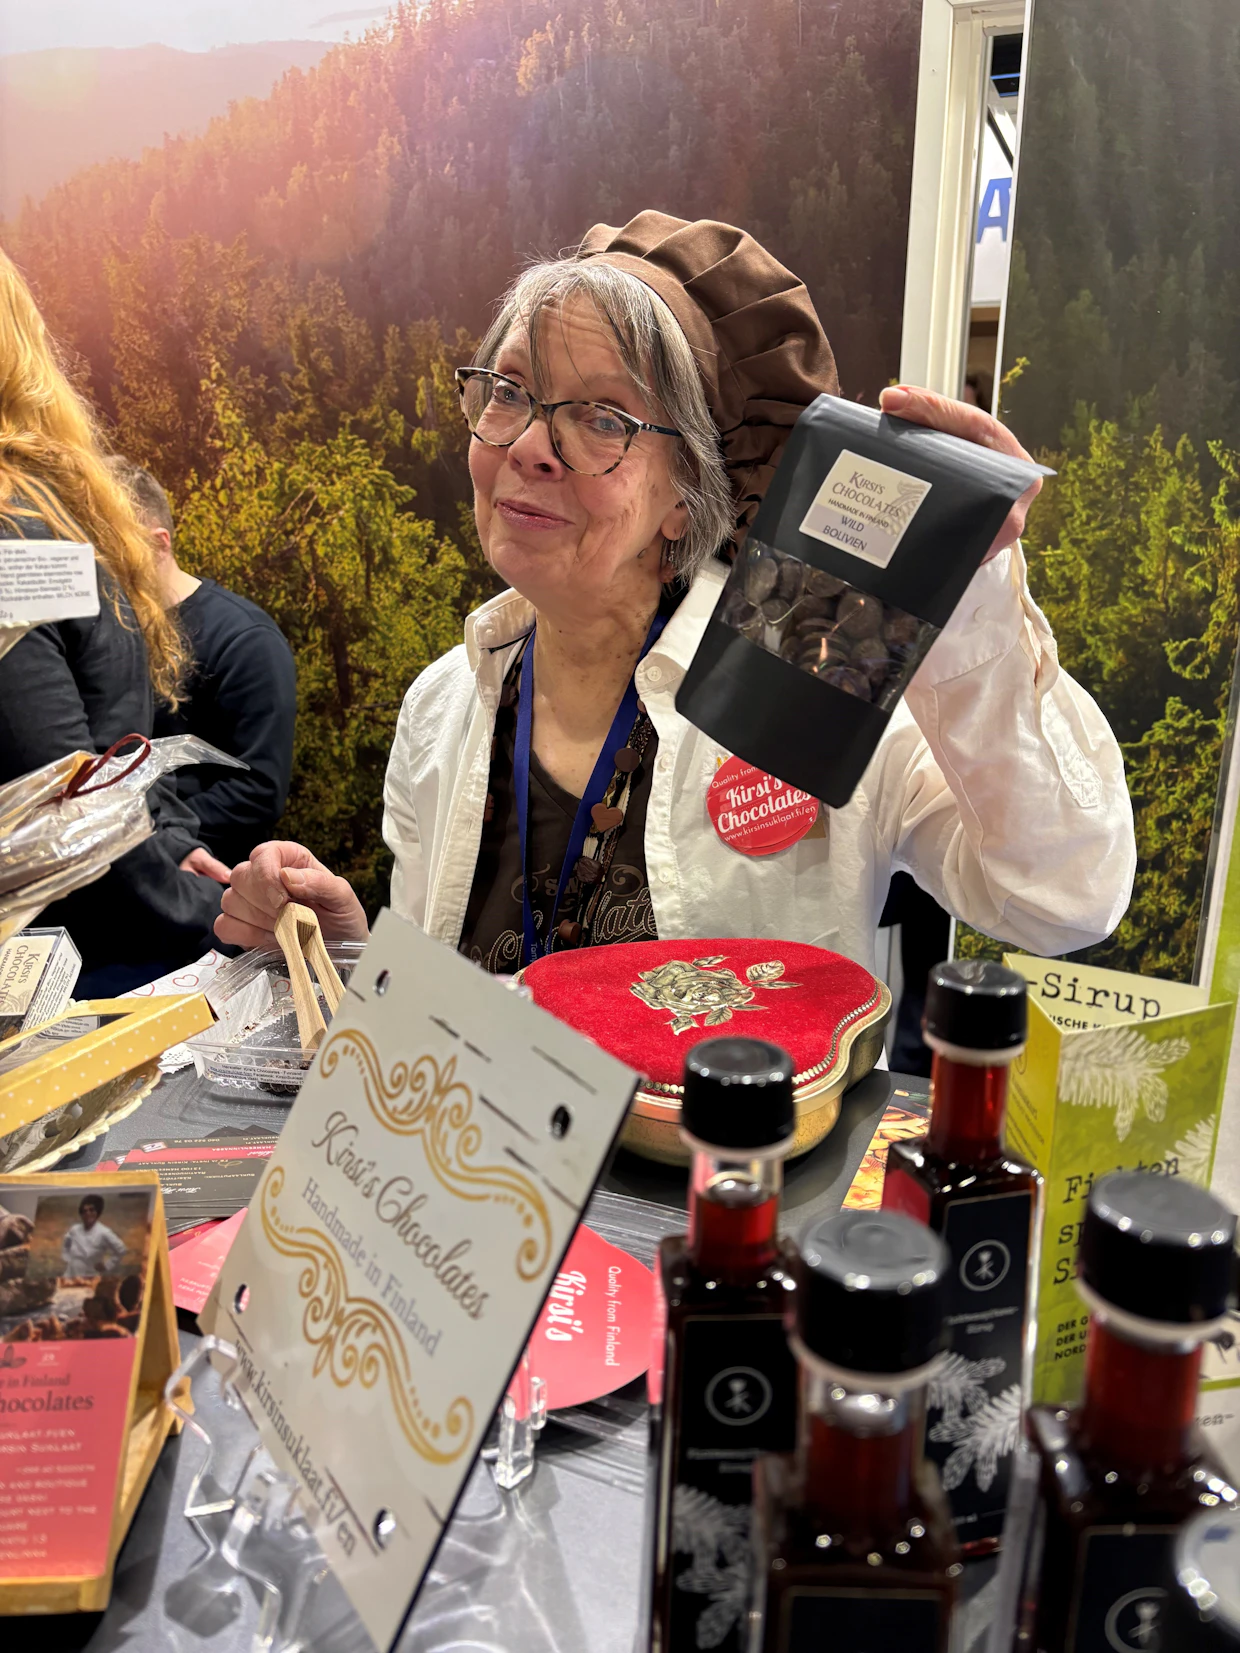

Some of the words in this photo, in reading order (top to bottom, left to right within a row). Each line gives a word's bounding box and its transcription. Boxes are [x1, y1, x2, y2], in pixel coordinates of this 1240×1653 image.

[828, 498, 858, 516] HANDMADE
[865, 513, 889, 528] FINLAND
[832, 482, 901, 518] CHOCOLATES
[822, 525, 868, 551] BOLIVIEN
[841, 515, 865, 533] WILD
[712, 773, 739, 789] Quality
[726, 774, 783, 809] Kirsi's
[717, 789, 812, 834] Chocolates
[724, 806, 816, 842] www.kirsinsuklaat.fi/en
[1049, 1014, 1088, 1030] ISCHE
[312, 1111, 379, 1197] Kirsi's
[376, 1176, 492, 1320] Chocolates
[302, 1177, 365, 1266] Handmade
[365, 1255, 382, 1287] in
[384, 1272, 444, 1358] Finland
[605, 1266, 622, 1298] Quality
[545, 1270, 587, 1341] Kirsi's
[607, 1300, 622, 1322] from
[1056, 1332, 1076, 1347] DER
[1057, 1317, 1077, 1333] DER
[604, 1326, 621, 1366] Finland
[22, 1374, 71, 1387] Finland
